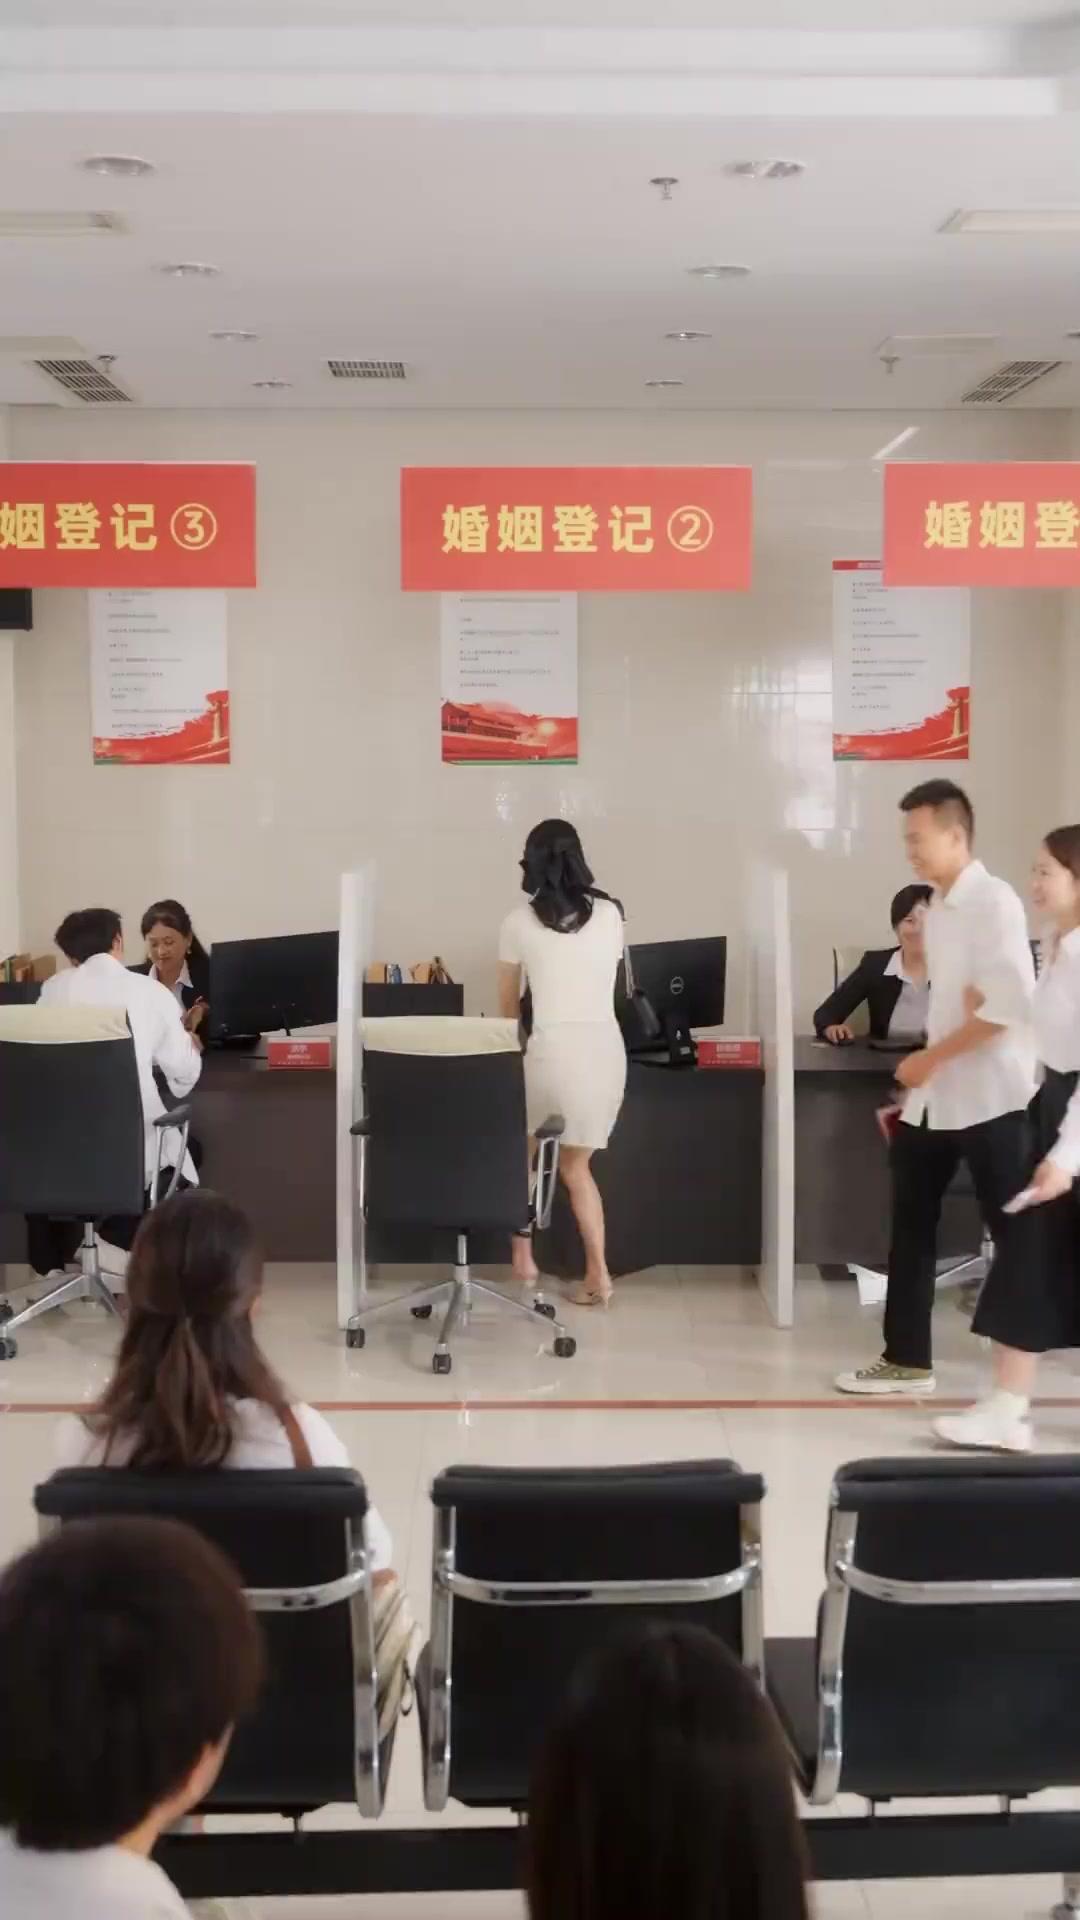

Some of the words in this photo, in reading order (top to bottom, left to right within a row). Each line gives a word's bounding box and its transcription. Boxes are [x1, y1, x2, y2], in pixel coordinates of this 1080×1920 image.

[441, 504, 714, 554] 婚姻登记②
[923, 500, 1080, 549] 婚姻登
